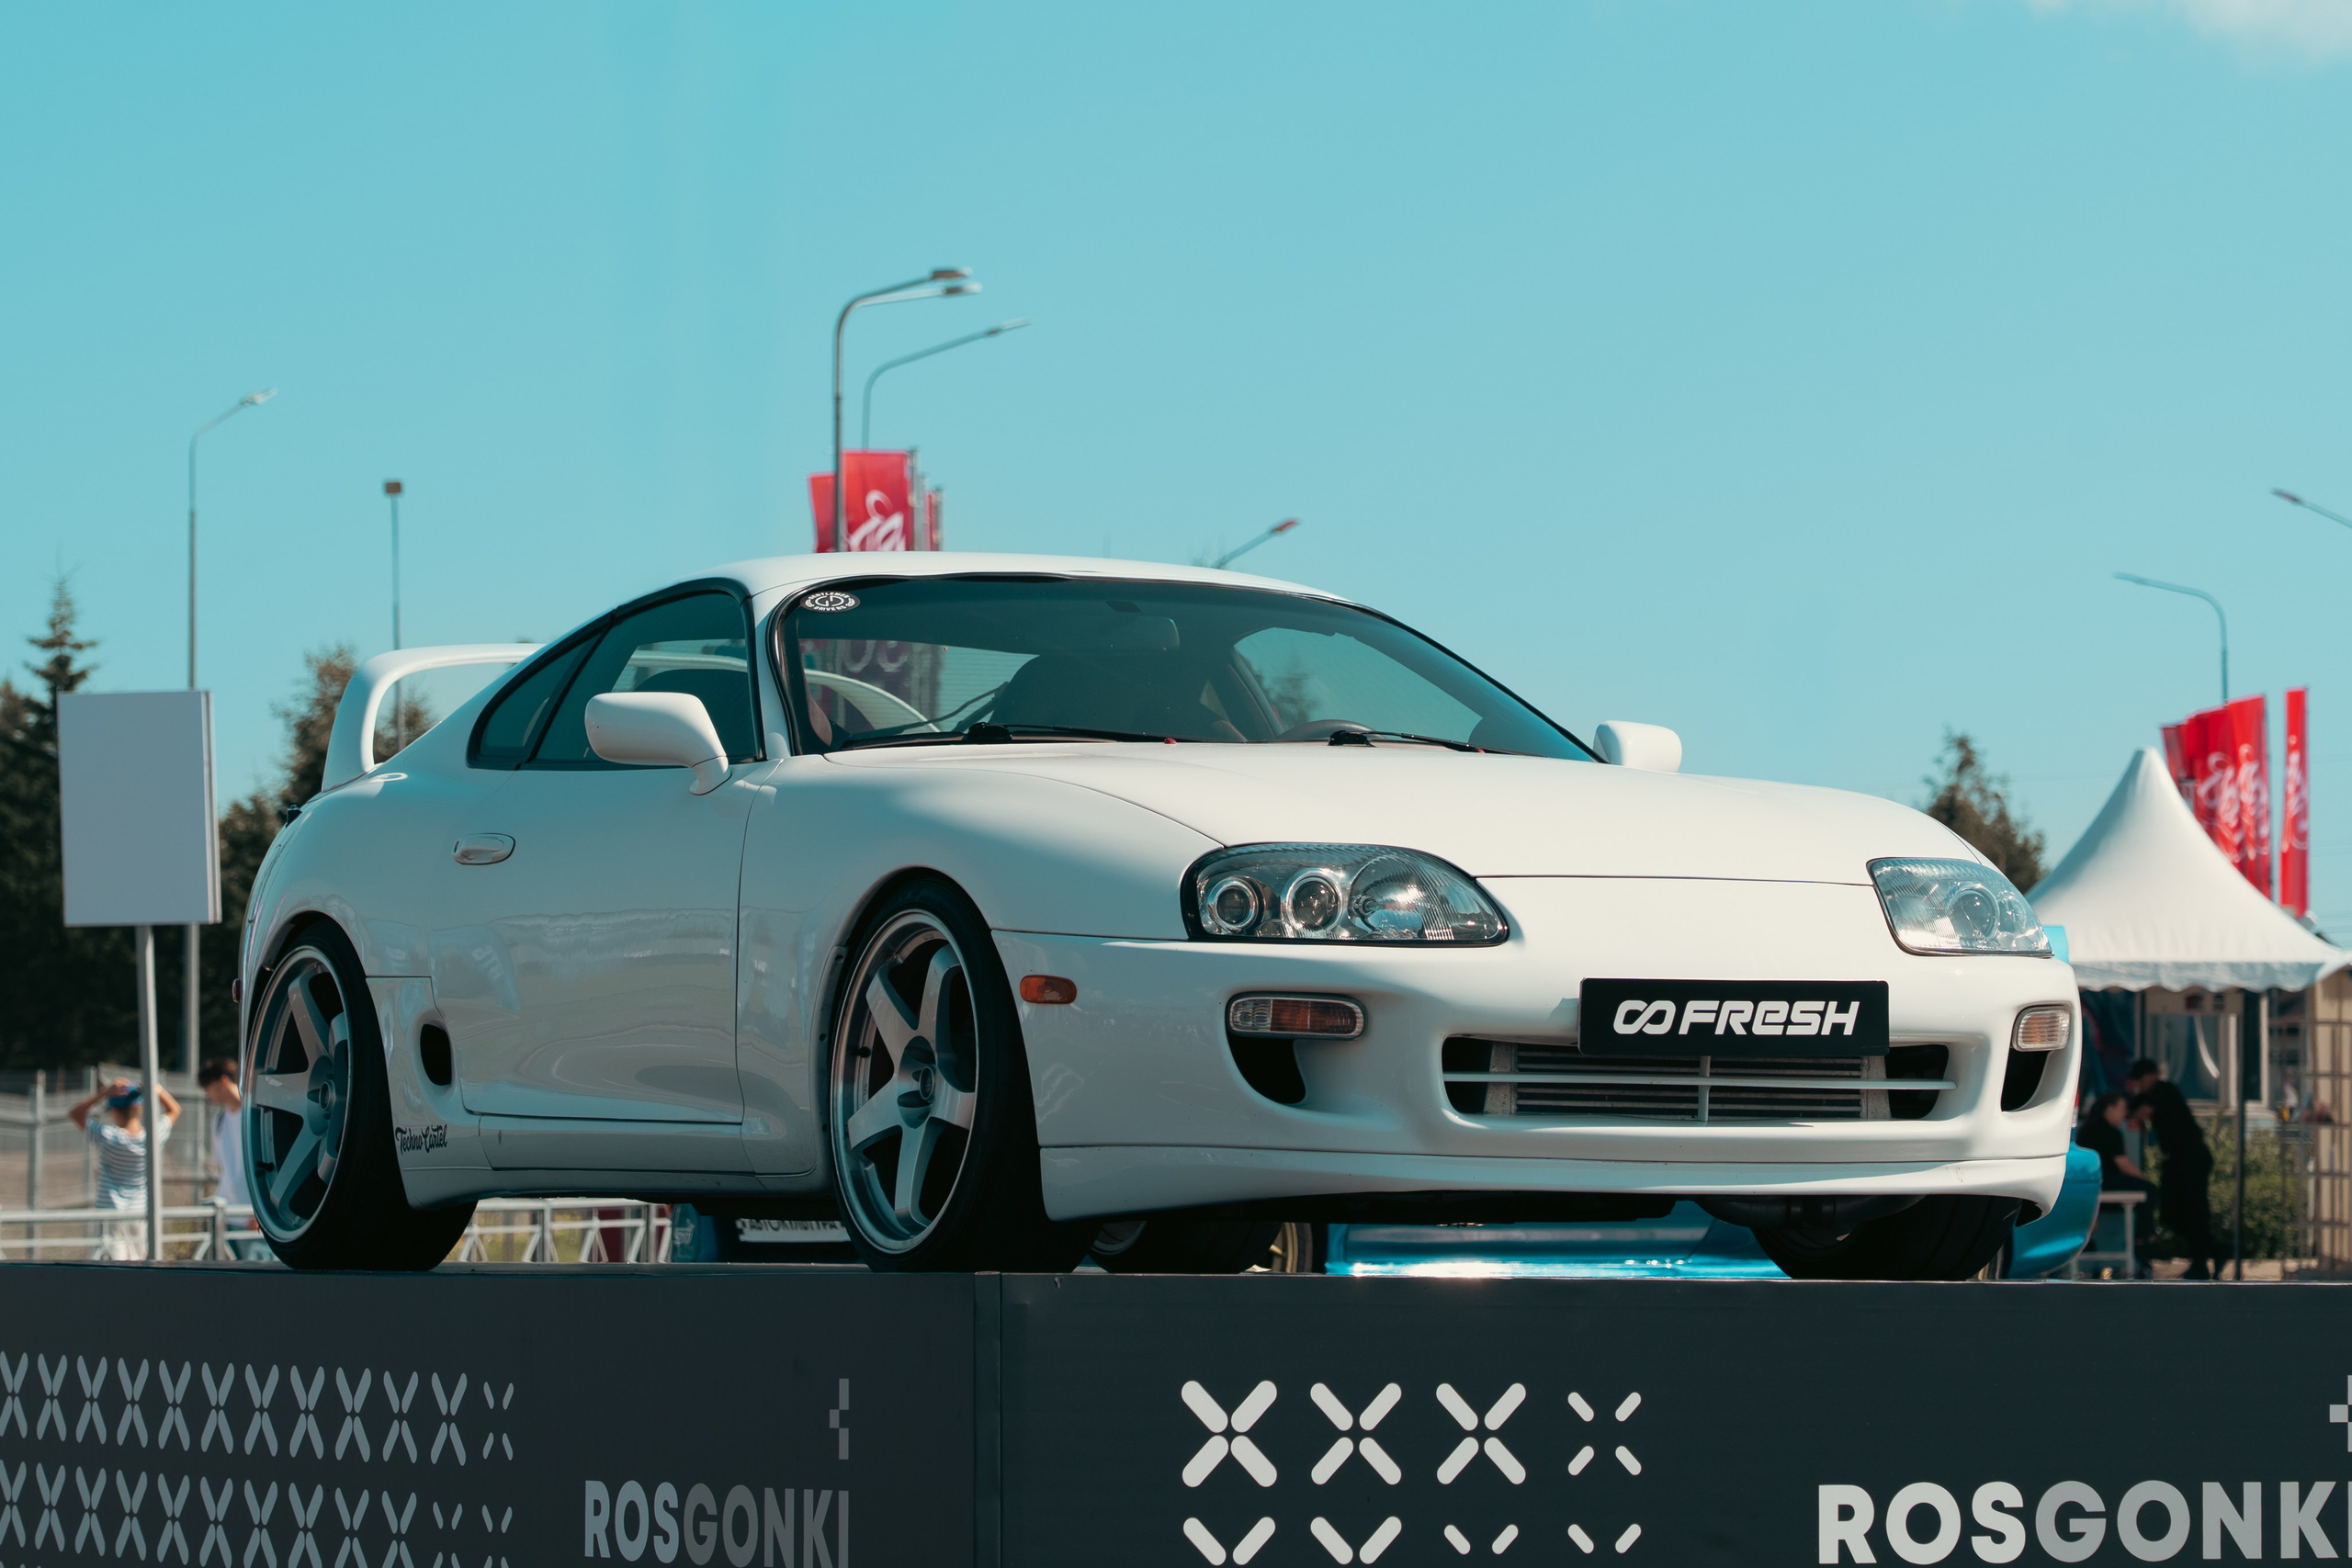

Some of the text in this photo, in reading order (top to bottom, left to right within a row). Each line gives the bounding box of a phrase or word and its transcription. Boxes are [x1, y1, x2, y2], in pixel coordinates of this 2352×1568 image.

[395, 1126, 424, 1156] Techno
[584, 1480, 850, 1568] ROSGONKI
[1817, 1480, 2352, 1565] ROSGONK
